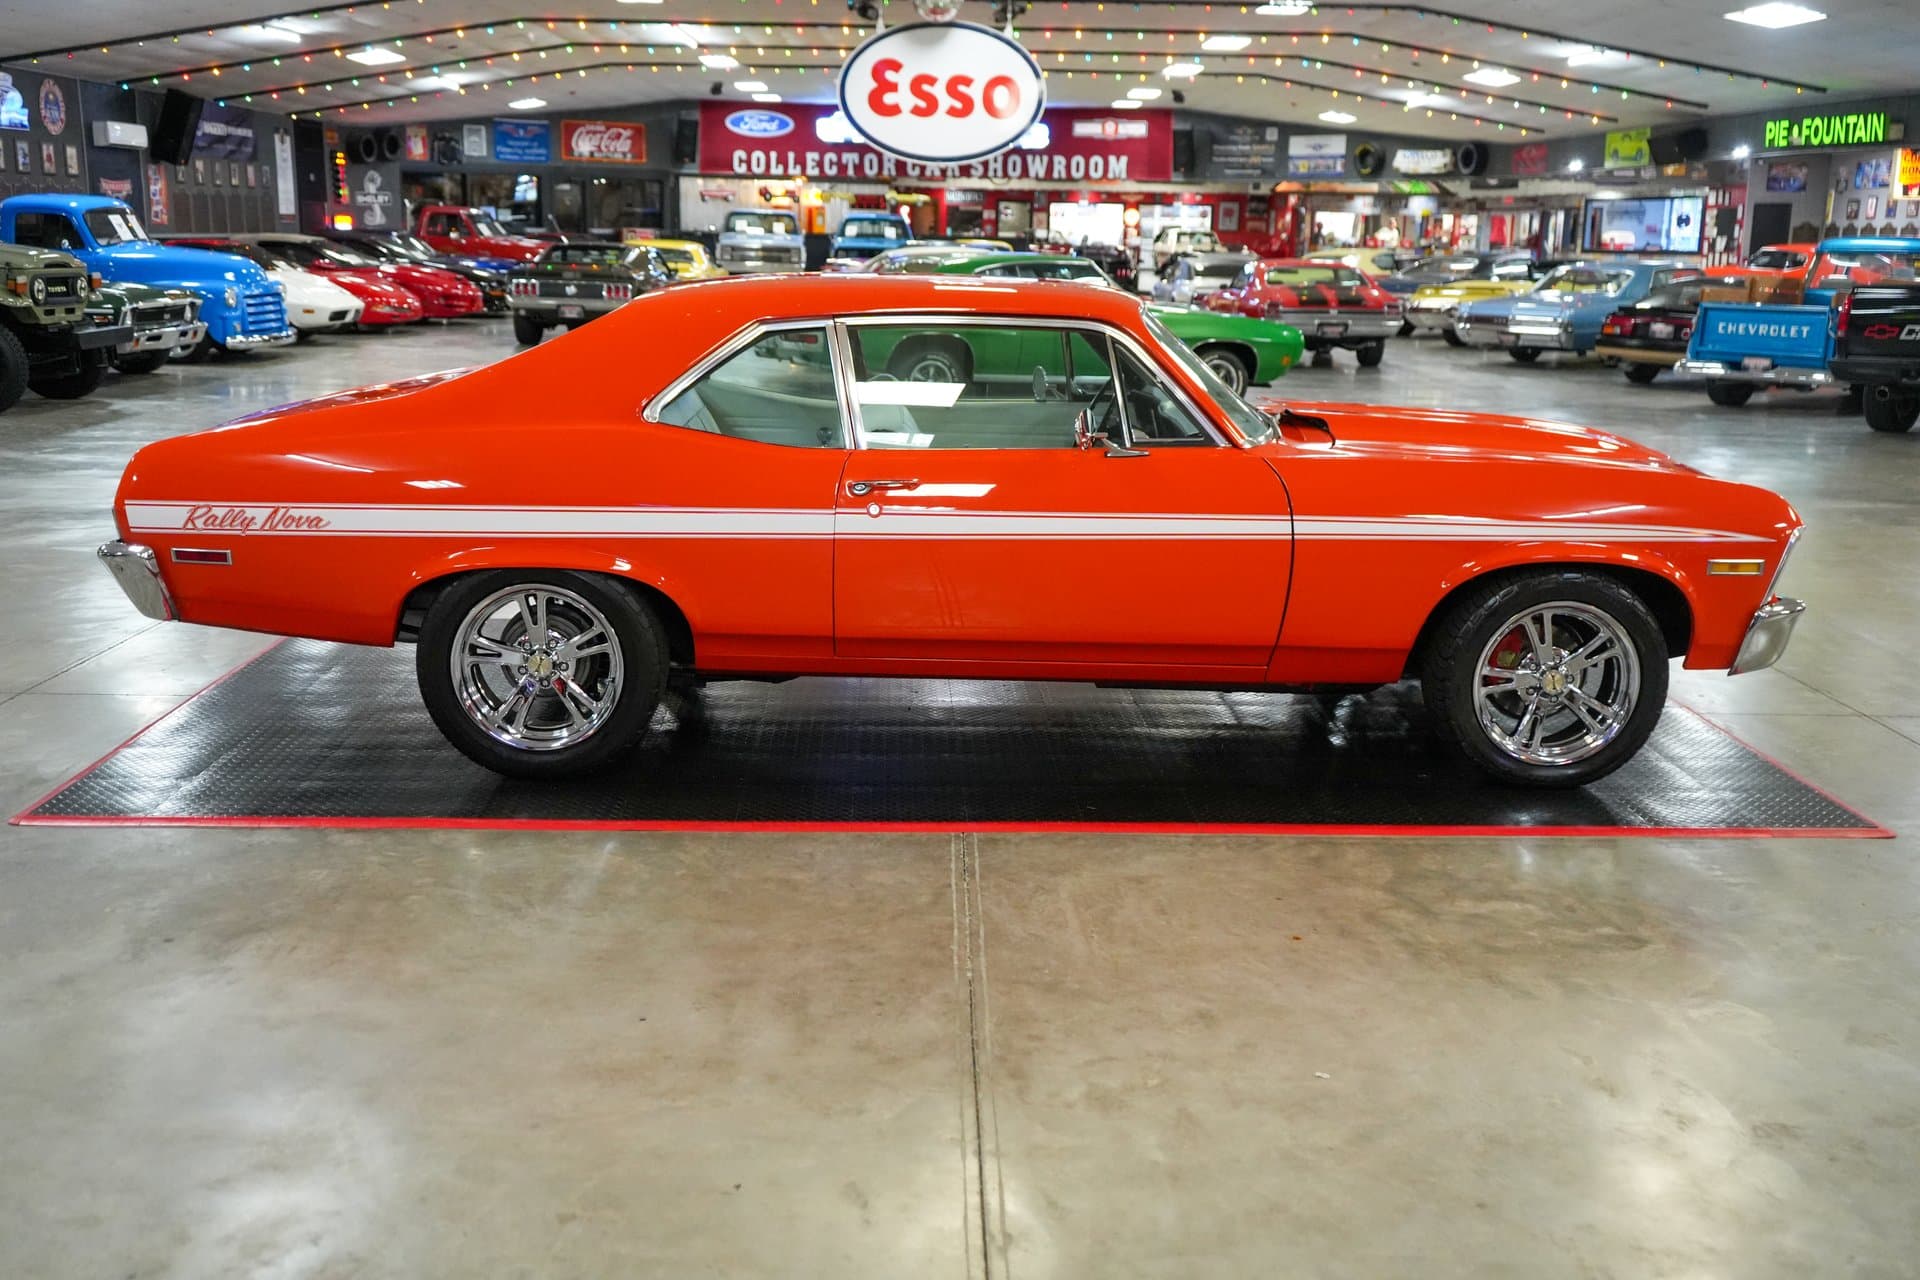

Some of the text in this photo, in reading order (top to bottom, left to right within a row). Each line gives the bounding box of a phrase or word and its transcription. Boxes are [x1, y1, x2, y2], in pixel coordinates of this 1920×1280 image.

[738, 113, 780, 132] Ford
[1765, 112, 1886, 148] PIE FOUNTAIN
[732, 149, 896, 177] COLLECTOR
[969, 153, 1128, 179] SHOWROOM
[1717, 321, 1811, 339] CHEVROLET
[182, 504, 331, 536] Rally Nova
